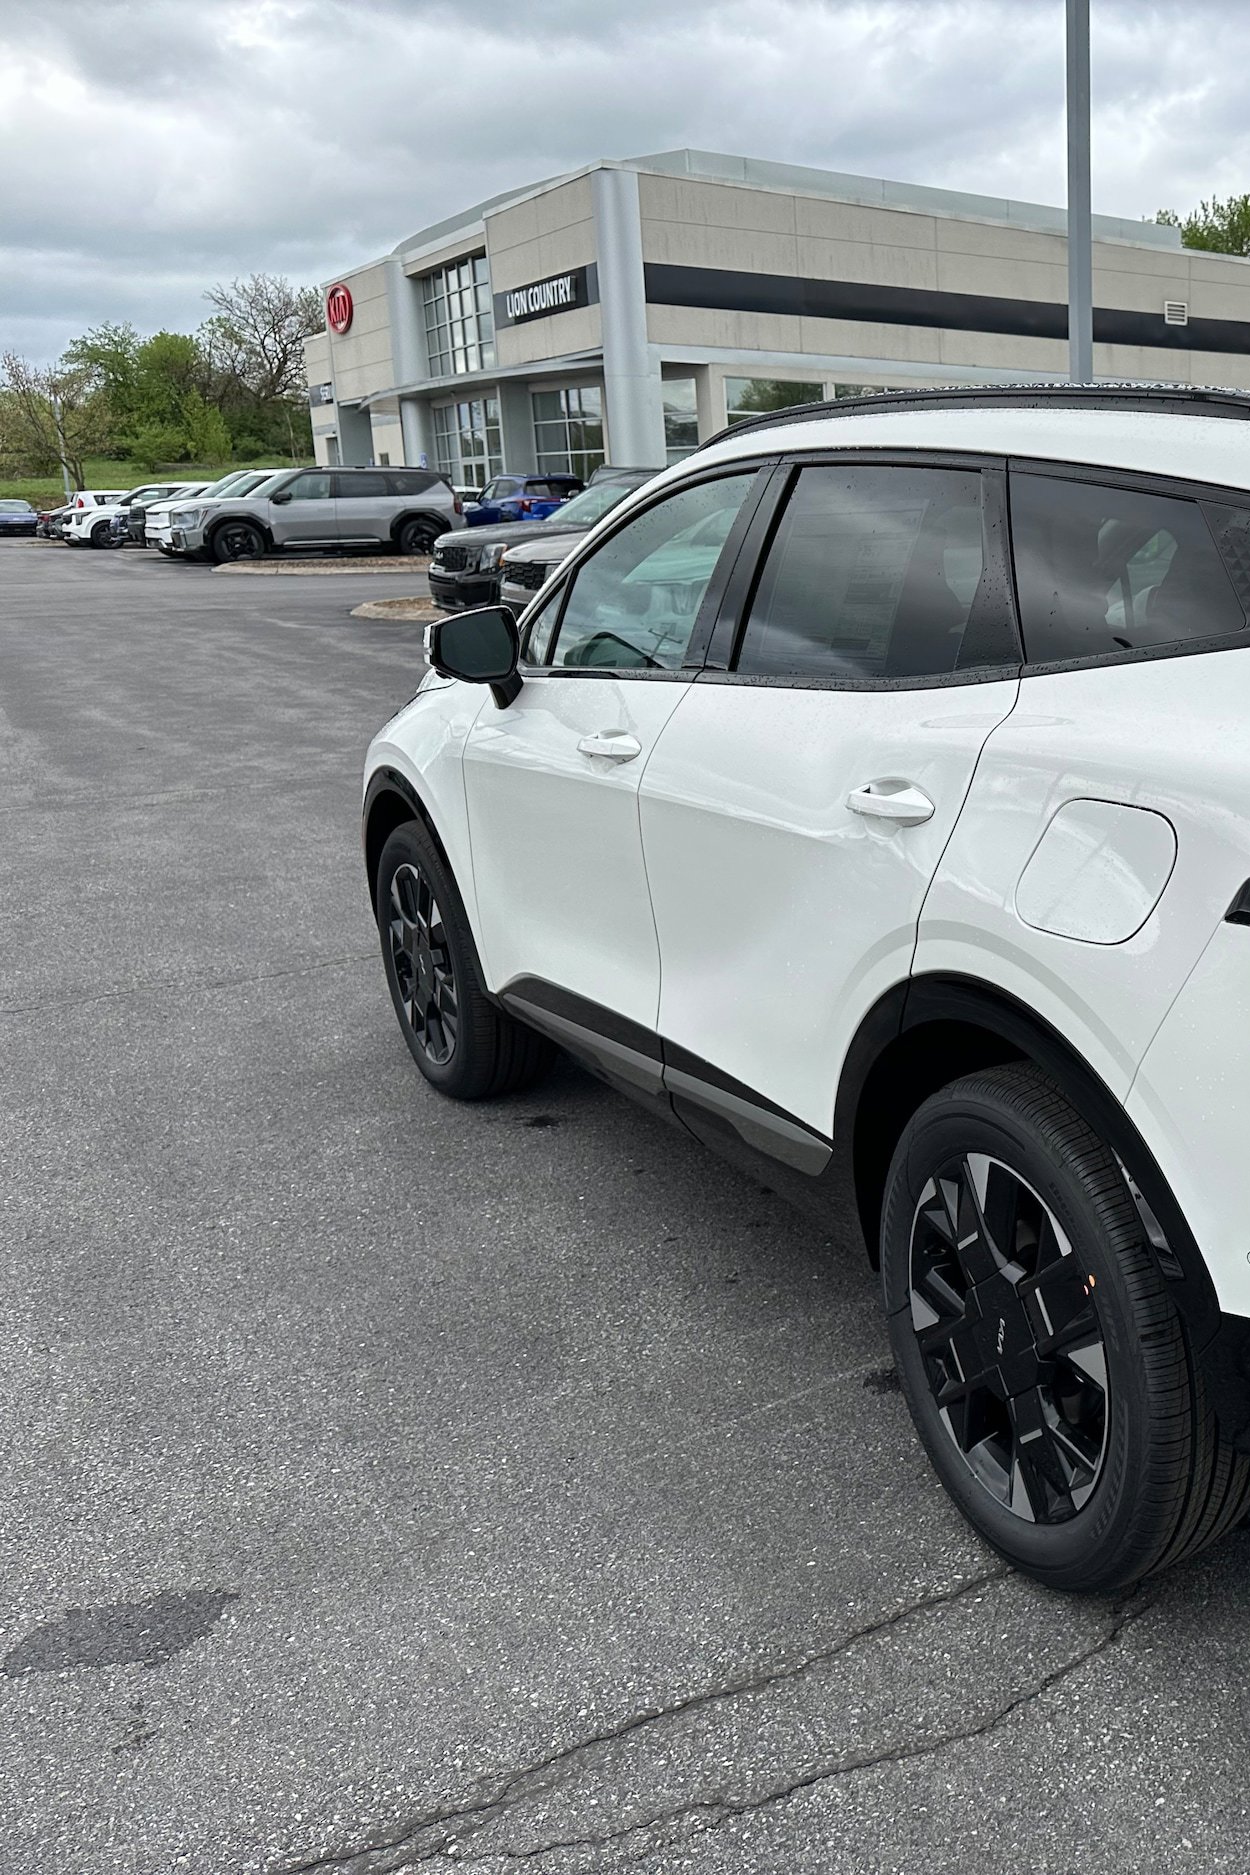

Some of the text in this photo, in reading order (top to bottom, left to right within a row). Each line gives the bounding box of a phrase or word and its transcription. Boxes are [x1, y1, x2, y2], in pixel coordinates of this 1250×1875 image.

[329, 294, 349, 323] KIA
[506, 275, 571, 318] LION COUNTRY
